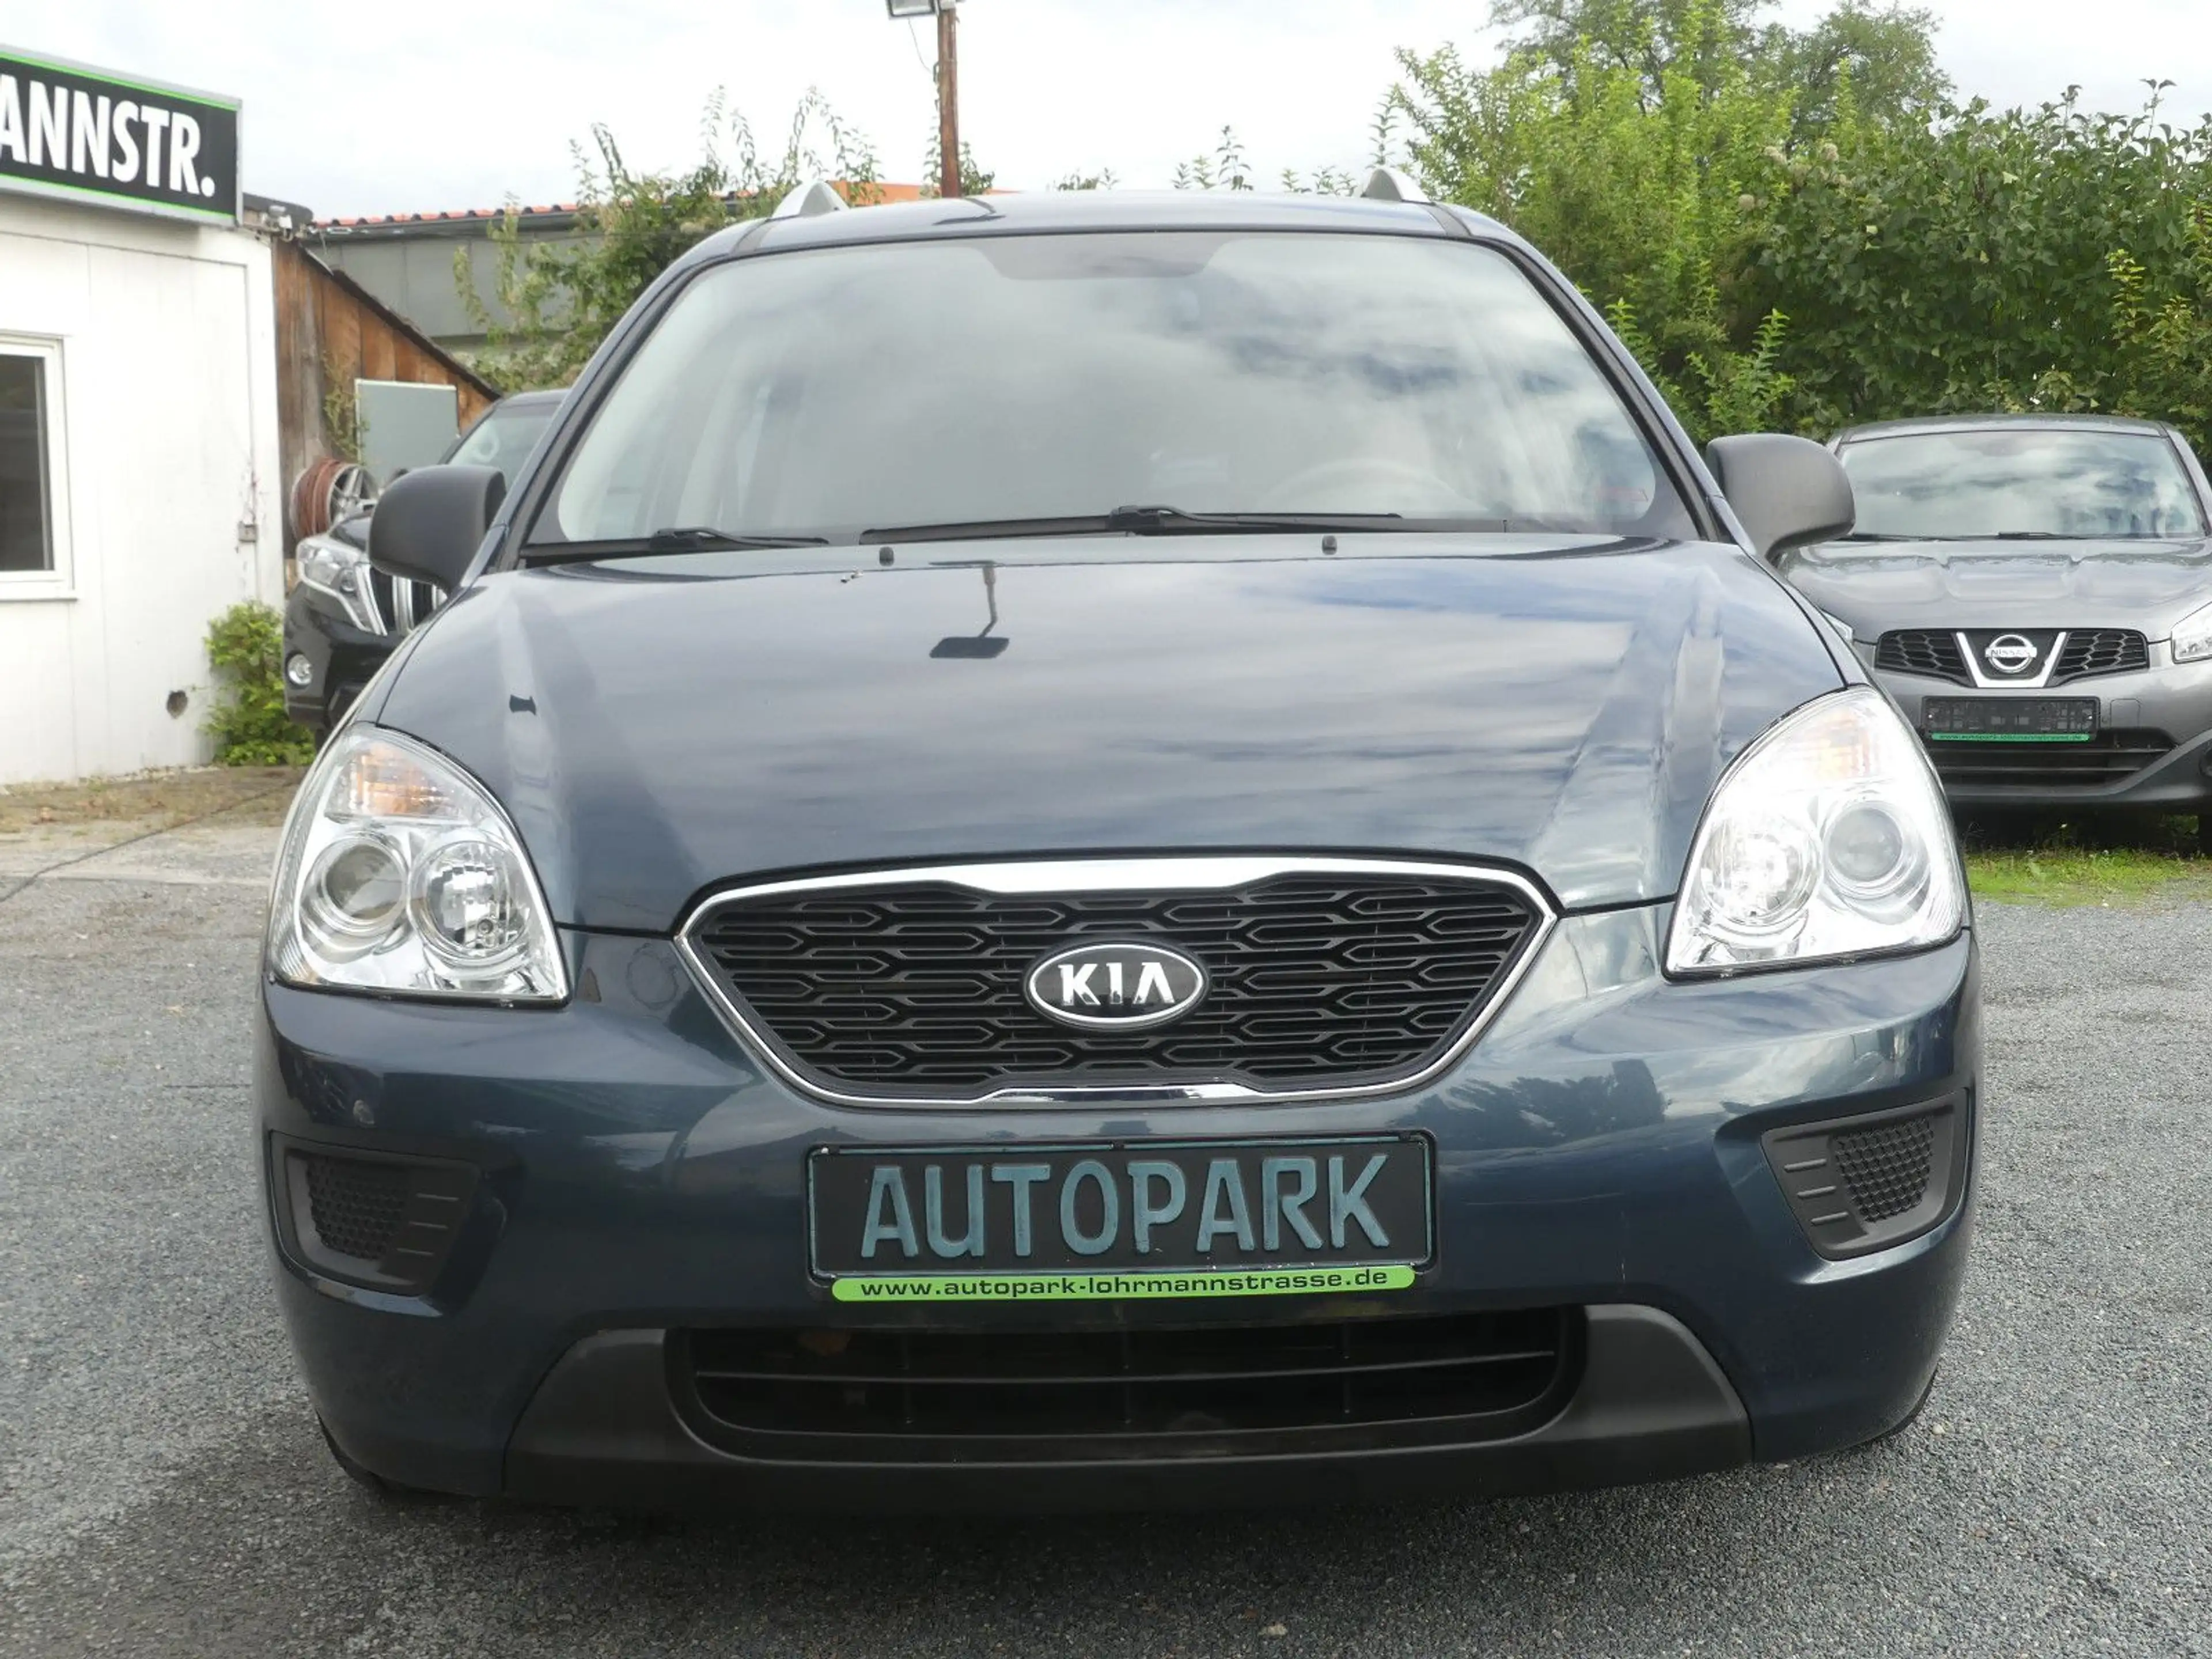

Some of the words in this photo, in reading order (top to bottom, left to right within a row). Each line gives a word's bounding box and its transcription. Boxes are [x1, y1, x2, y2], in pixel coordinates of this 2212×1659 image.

[0, 73, 215, 198] ANNSTR.
[1058, 962, 1175, 1006] KIA
[861, 1154, 1390, 1258] AUTOPARK
[861, 1269, 1388, 1297] www.autopark-lohrmannstrasse.de
